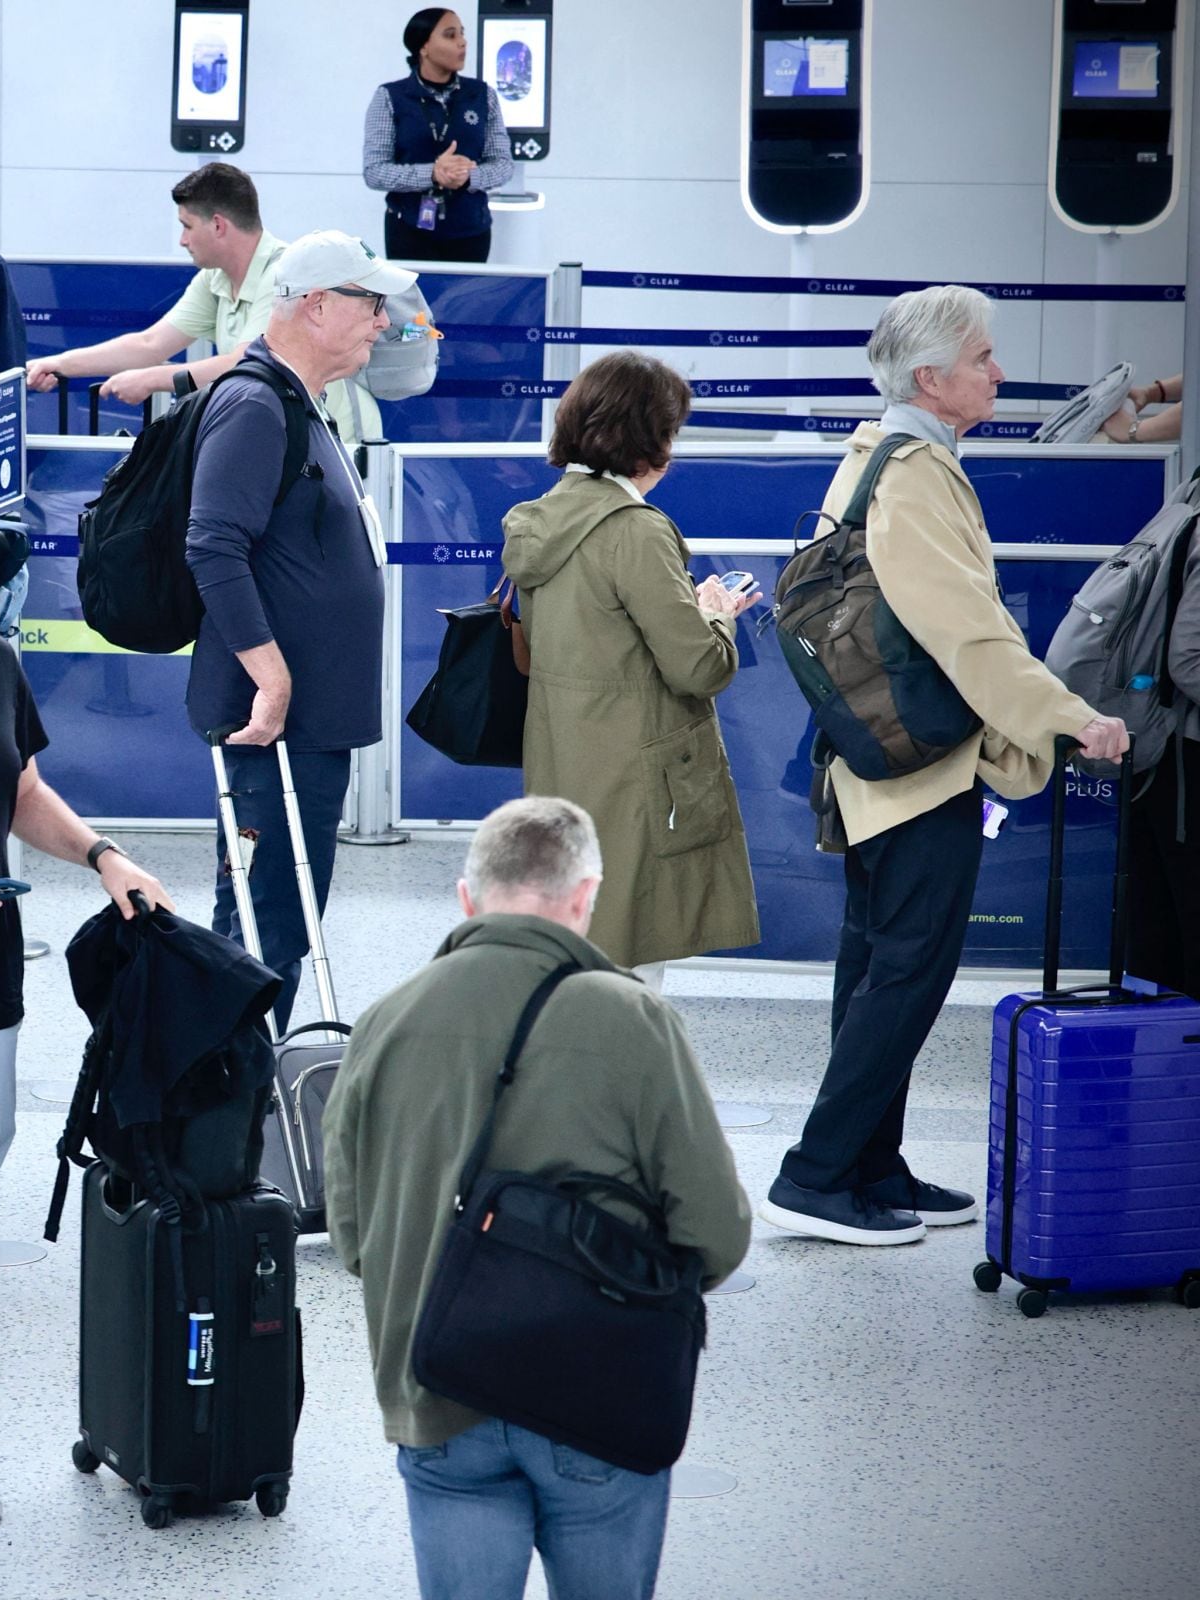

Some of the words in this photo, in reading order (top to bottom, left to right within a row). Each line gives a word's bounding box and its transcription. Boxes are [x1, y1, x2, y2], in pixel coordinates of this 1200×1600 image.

[825, 283, 855, 291] CLEAR
[544, 331, 576, 339] CLEAR
[727, 335, 759, 343] CLEAR
[821, 421, 850, 429] CLEAR
[998, 426, 1028, 434] CLEAR
[31, 541, 55, 550] EAR
[455, 549, 493, 558] CLEAR
[1065, 782, 1112, 797] PLUS
[968, 914, 1023, 923] arme.com
[204, 1328, 214, 1372] MileagePlus
